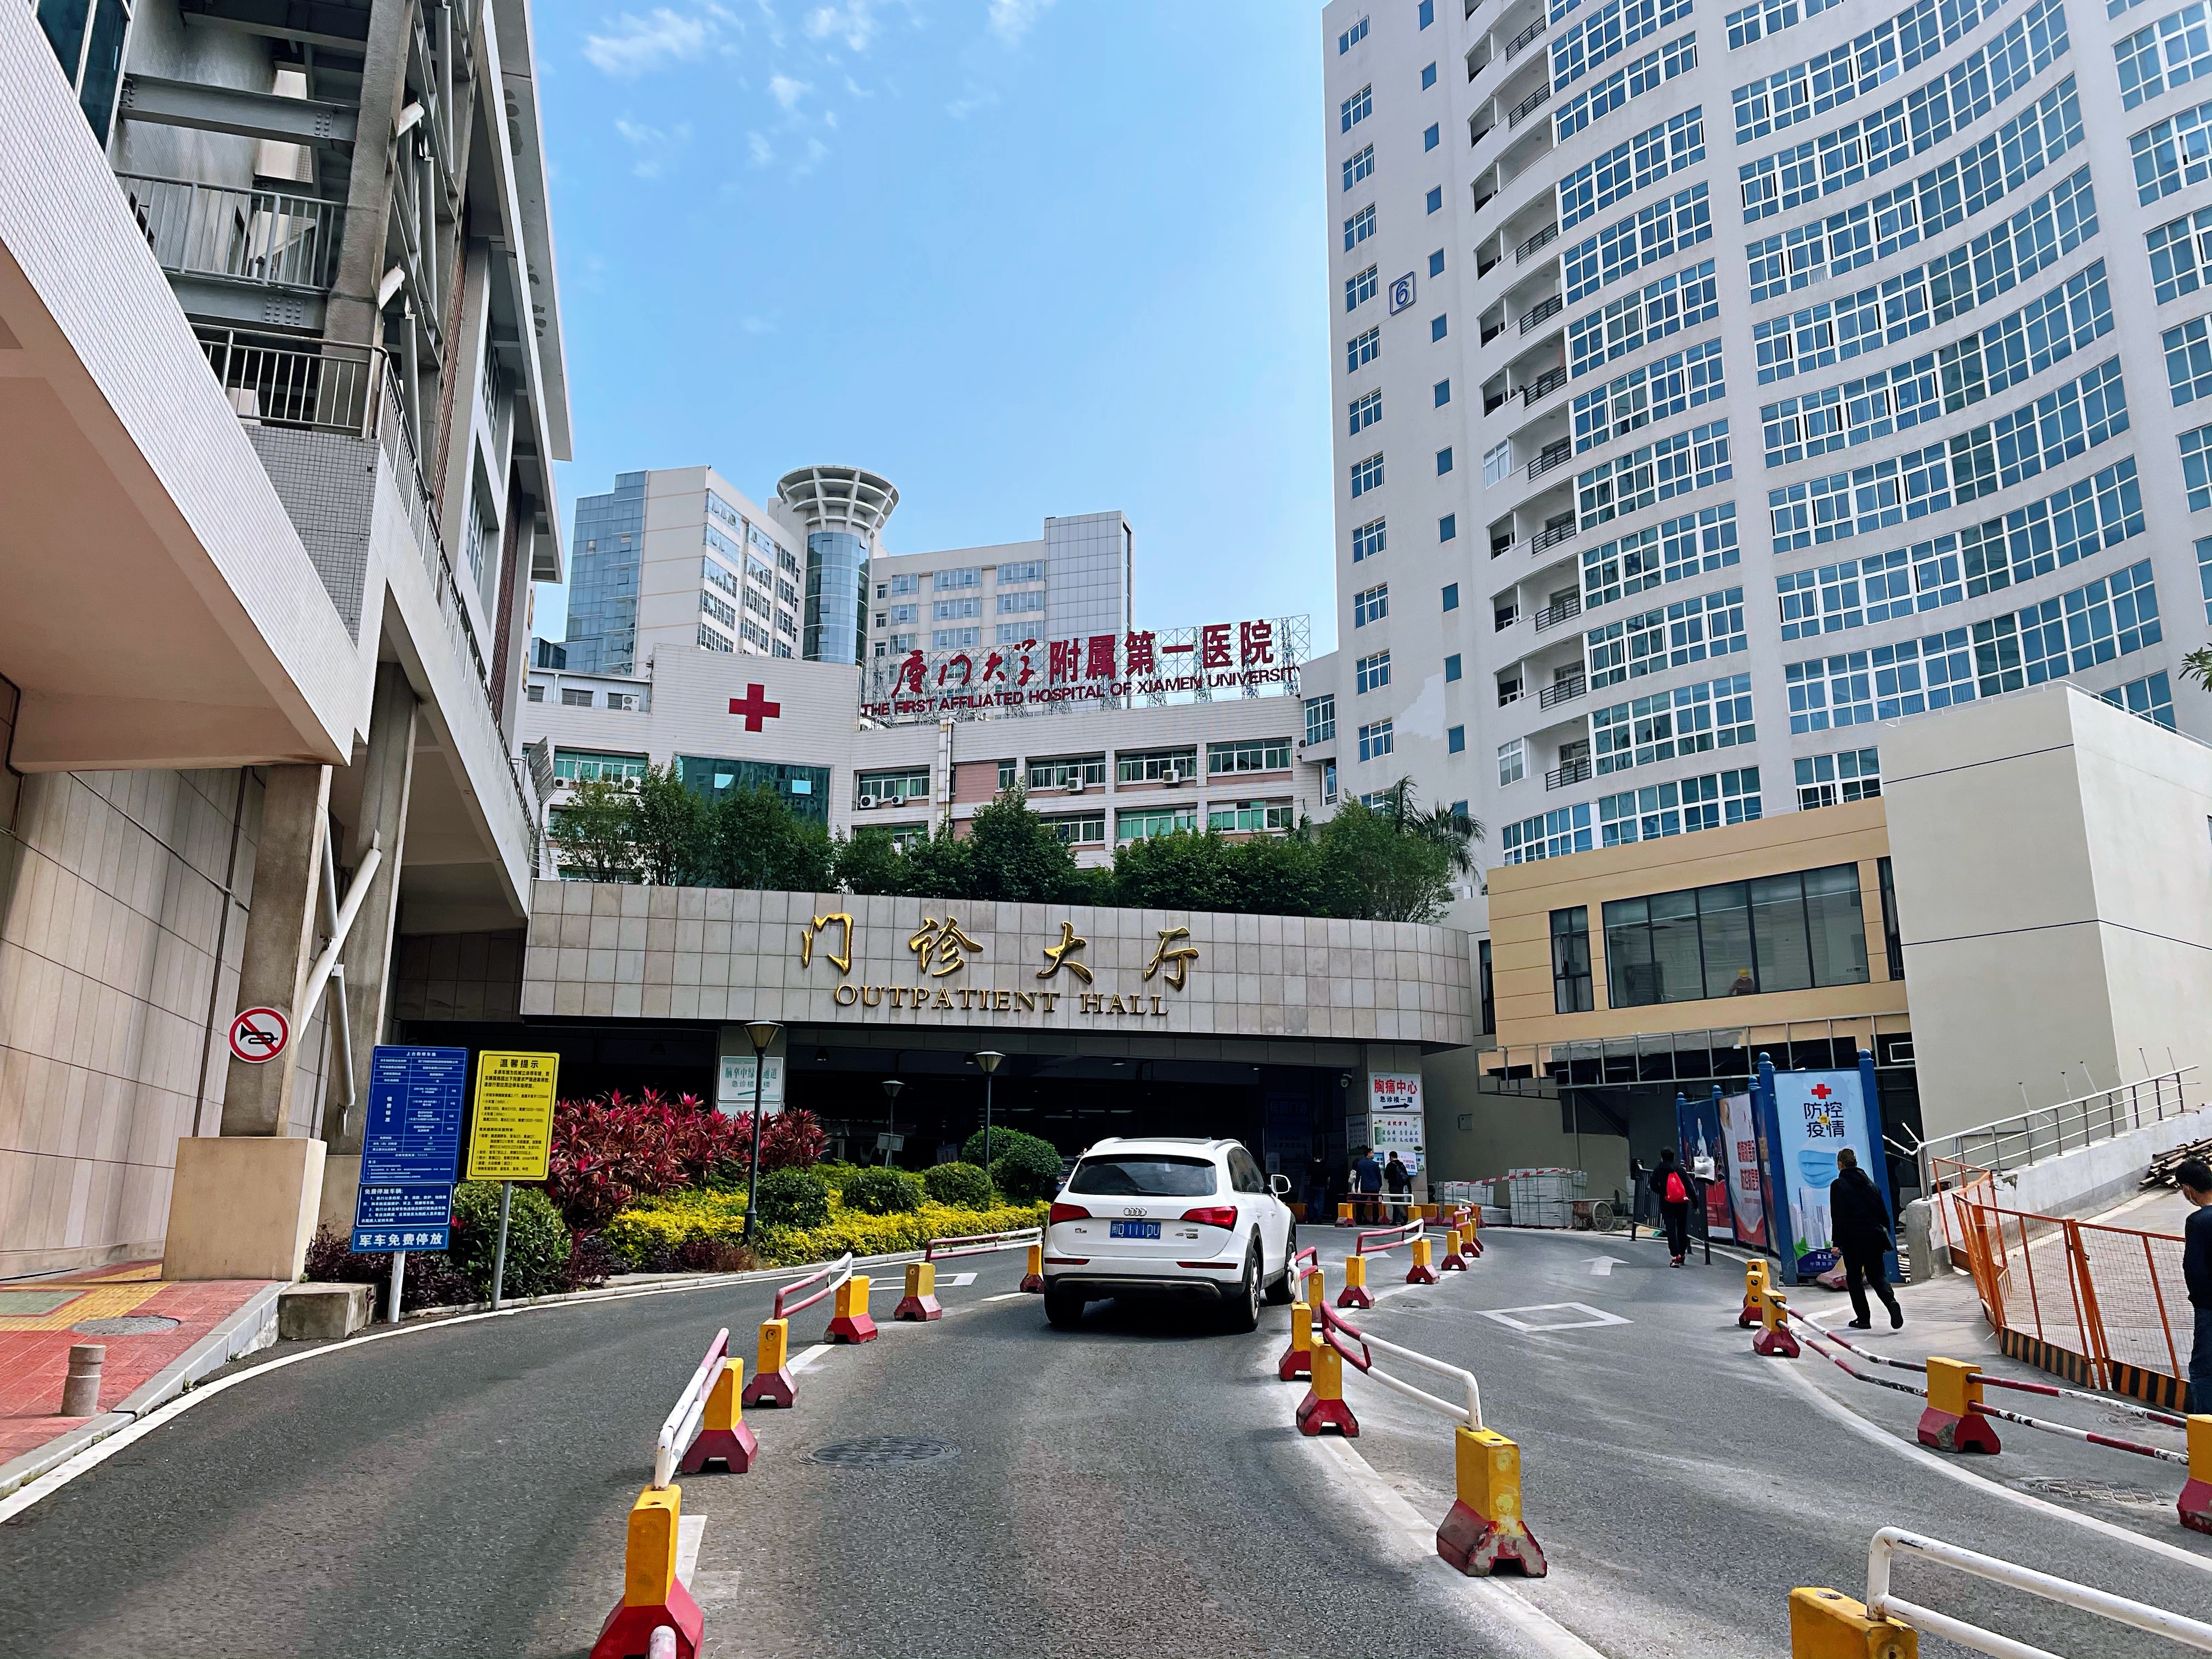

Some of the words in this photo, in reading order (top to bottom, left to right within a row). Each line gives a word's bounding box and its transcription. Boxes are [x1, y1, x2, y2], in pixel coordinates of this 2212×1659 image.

[1396, 280, 1408, 305] 6
[891, 619, 1274, 698] 厦门大学附属第一医院
[862, 702, 890, 716] THE
[894, 699, 934, 714] FIRST
[939, 691, 1024, 712] AFFILIATED
[1029, 684, 1105, 703] HOSPITAL
[1110, 681, 1132, 696] OF
[1137, 676, 1203, 694] XIAMEN
[802, 913, 1199, 992] 门诊大厅
[833, 984, 1061, 1013] OUTPATIENT
[1080, 993, 1169, 1016] HALL
[500, 1059, 539, 1068] 温馨提示
[725, 1067, 777, 1079] 脑卒中绿通道
[1374, 1079, 1418, 1094] 胸痛中心
[1803, 1102, 1843, 1119] 防控
[1806, 1120, 1845, 1138] 疫情
[359, 1233, 443, 1246] 军车免费停放
